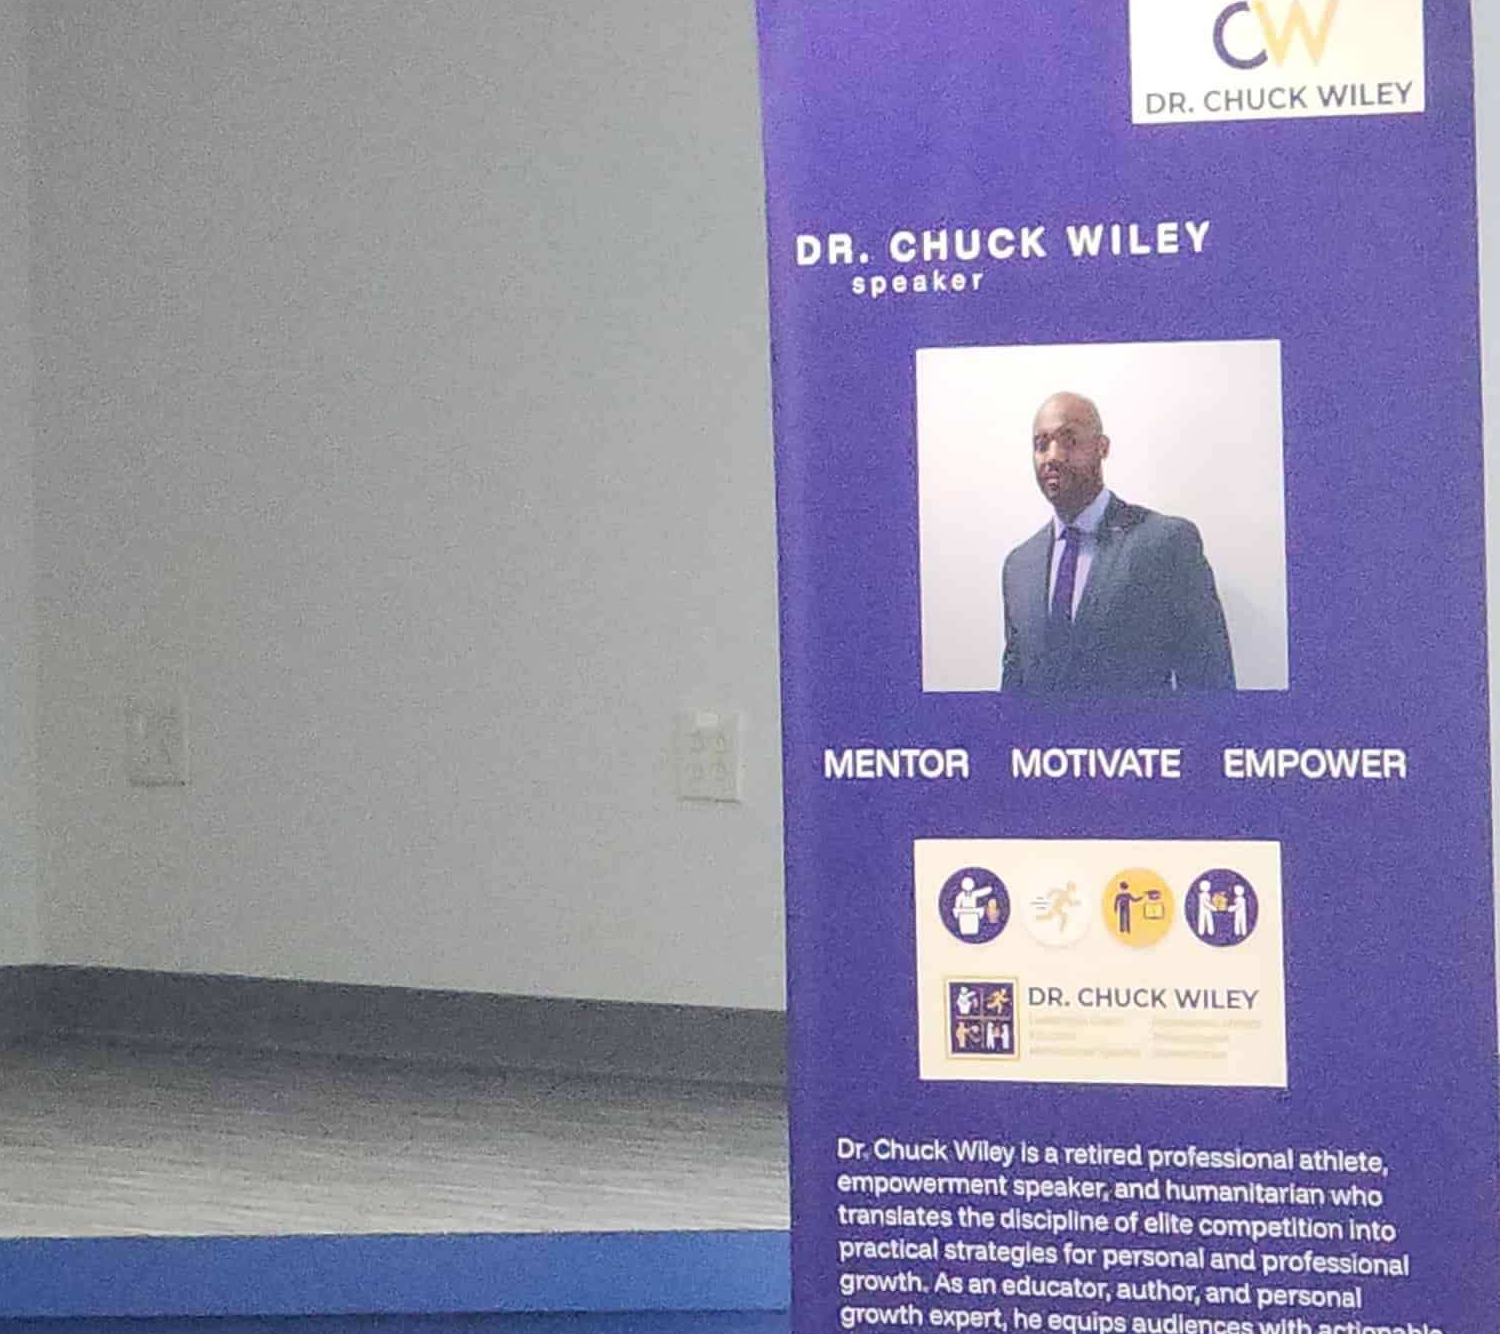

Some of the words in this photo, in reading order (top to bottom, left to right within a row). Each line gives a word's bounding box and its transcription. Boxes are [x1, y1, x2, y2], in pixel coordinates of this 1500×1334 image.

[1145, 91, 1194, 115] DR.
[1203, 85, 1308, 112] CHUCK
[1315, 80, 1414, 108] WILEY
[795, 232, 869, 266] DR.
[889, 225, 1047, 263] CHUCK
[1066, 220, 1211, 257] WILEY
[851, 269, 985, 298] speaker
[823, 747, 970, 779] MENTOR
[1011, 747, 1182, 779] MOTIVATE
[1222, 747, 1408, 780] EMPOWER
[1027, 986, 1071, 1008] DR.
[1077, 986, 1168, 1009] CHUCK
[1174, 988, 1260, 1010] WILEY
[873, 1137, 949, 1161] Chuck
[952, 1139, 1016, 1168] Wiley
[1020, 1140, 1040, 1164] is
[1044, 1146, 1059, 1165] a
[1063, 1142, 1144, 1167] retired
[1147, 1145, 1294, 1172] professional
[1298, 1149, 1389, 1177] athlete,
[837, 1174, 1008, 1198] empowerment
[1012, 1175, 1110, 1203] speaker,
[1114, 1178, 1161, 1200] and
[1165, 1178, 1325, 1205] humanitarian
[1328, 1184, 1383, 1207] who
[837, 1204, 954, 1228] translates
[957, 1205, 995, 1229] the
[999, 1207, 1110, 1236] discipline
[1114, 1210, 1139, 1233] of
[1143, 1210, 1194, 1236] elite
[1198, 1216, 1344, 1243] competition
[1349, 1218, 1397, 1243] into
[838, 1237, 939, 1263] practical
[943, 1239, 1058, 1268] strategies
[1062, 1242, 1098, 1265] for
[1102, 1246, 1205, 1270] personal
[1209, 1248, 1257, 1271] and
[1260, 1249, 1409, 1277] professional
[839, 1270, 929, 1296] growth.
[934, 1271, 964, 1294] As
[968, 1277, 997, 1295] an
[1001, 1274, 1112, 1303] educator,
[1115, 1278, 1201, 1306] author,
[1205, 1282, 1252, 1305] and
[1256, 1286, 1362, 1311] personal
[840, 1303, 924, 1329] growth
[928, 1307, 1008, 1333] expert,
[1013, 1306, 1043, 1330] he
